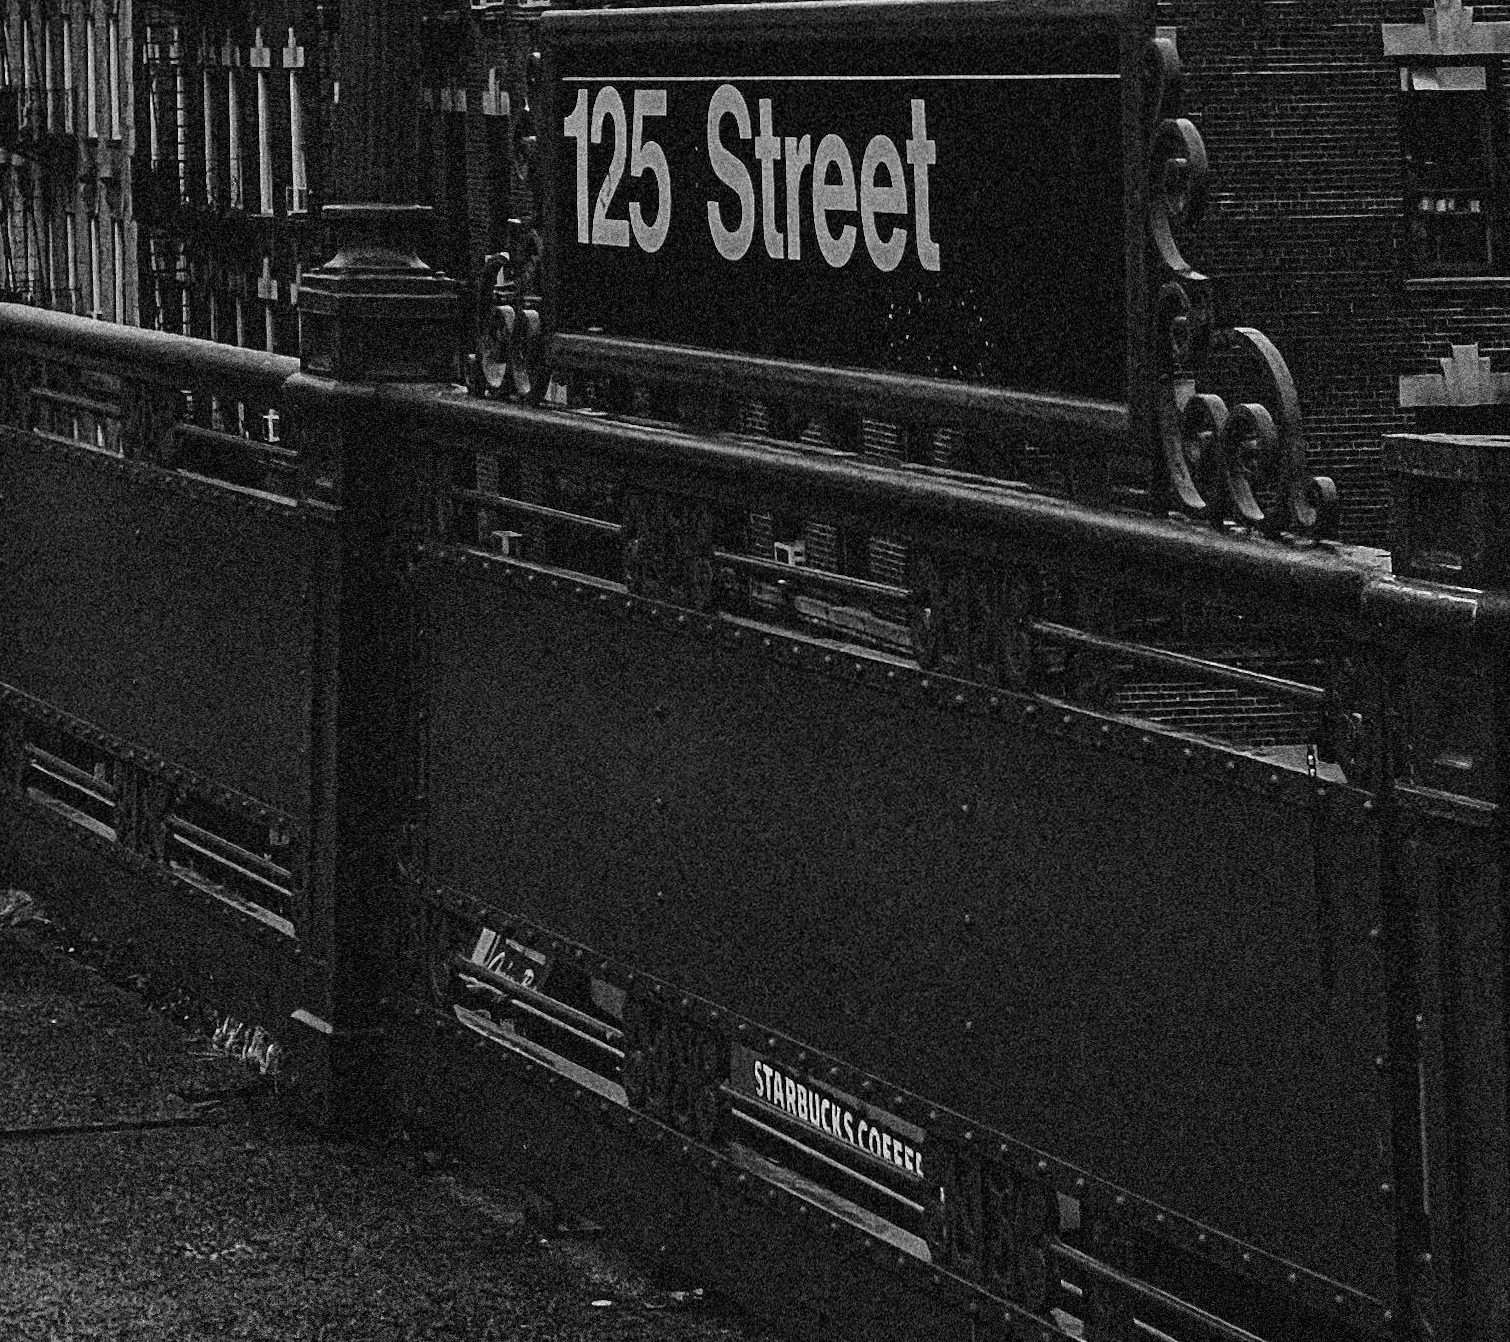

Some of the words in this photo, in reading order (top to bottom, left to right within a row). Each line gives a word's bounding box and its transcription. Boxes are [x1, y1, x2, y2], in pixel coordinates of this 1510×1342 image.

[563, 85, 672, 253] 125
[706, 83, 941, 272] Street
[754, 1060, 854, 1146] STARBUCKS
